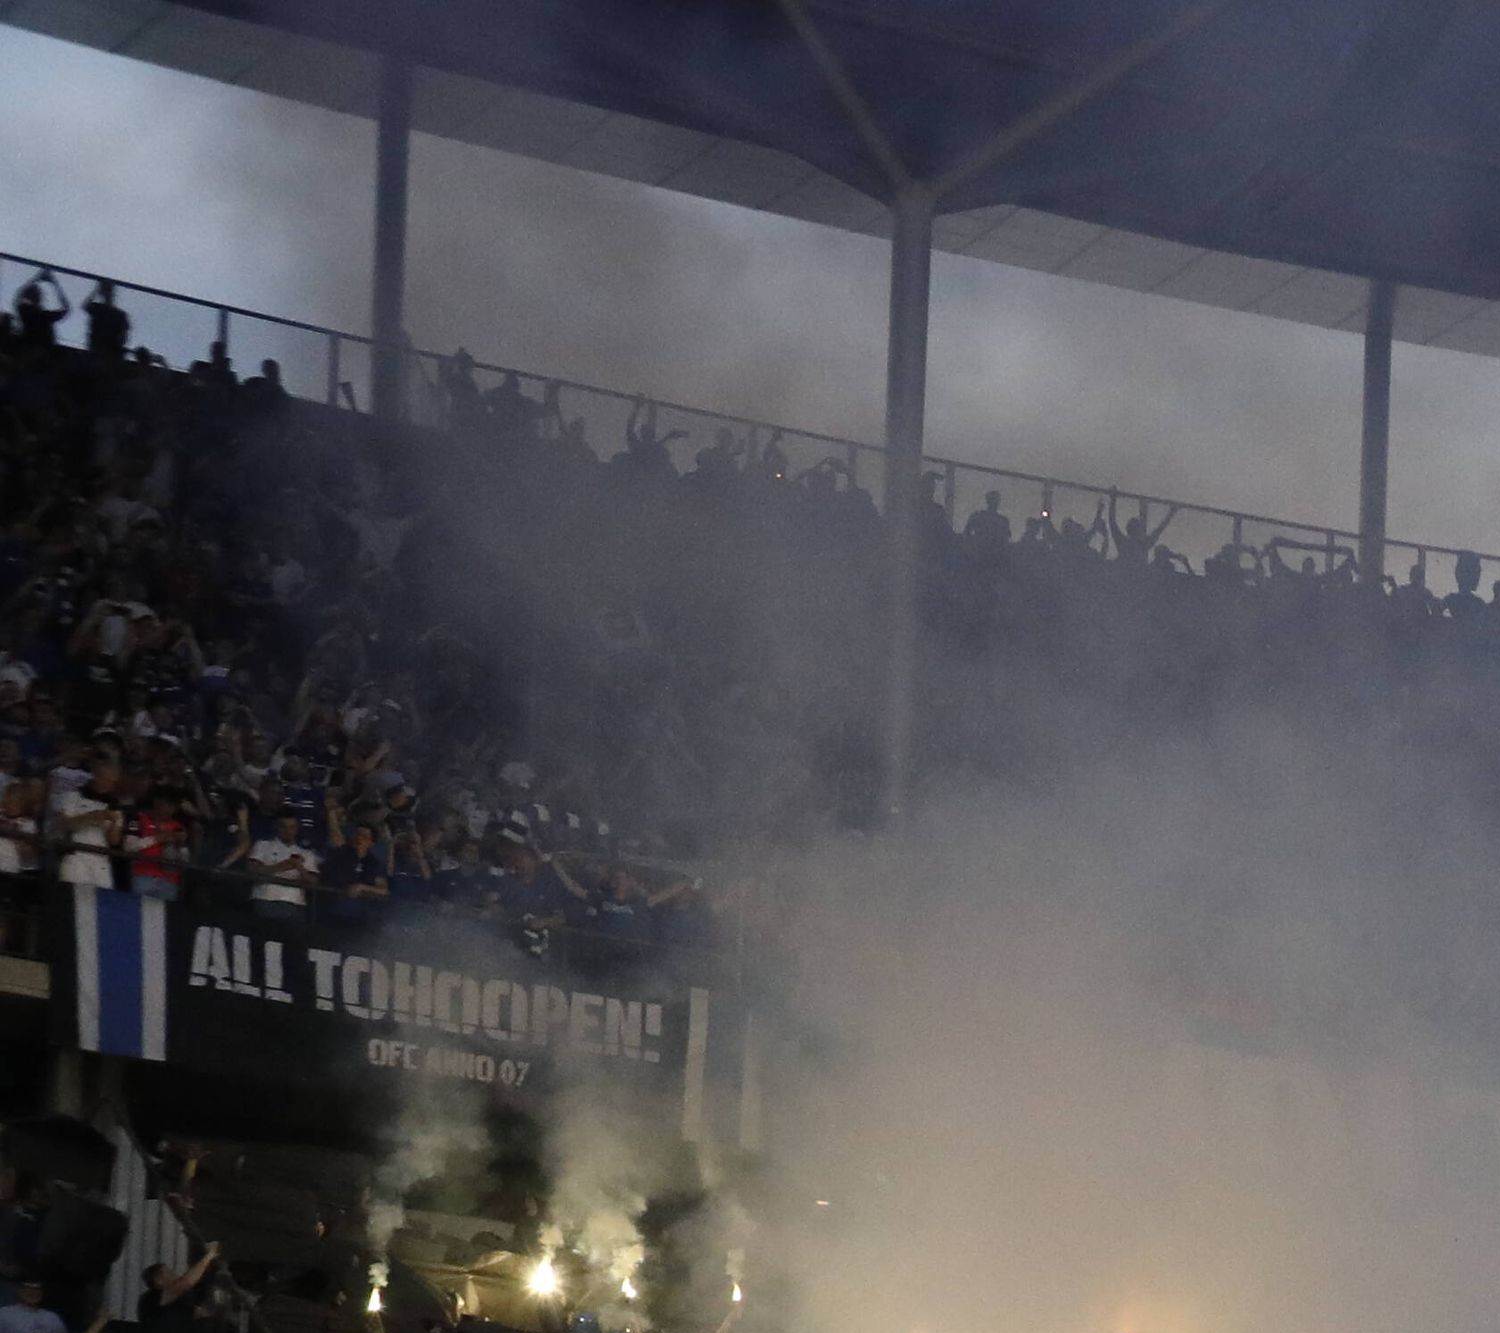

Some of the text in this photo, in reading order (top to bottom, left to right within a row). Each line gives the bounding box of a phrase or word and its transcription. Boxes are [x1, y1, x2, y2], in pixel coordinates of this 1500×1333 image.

[188, 925, 662, 1063] ALL TOHOOPEN!
[367, 1037, 531, 1088] OFC ANNO 07
